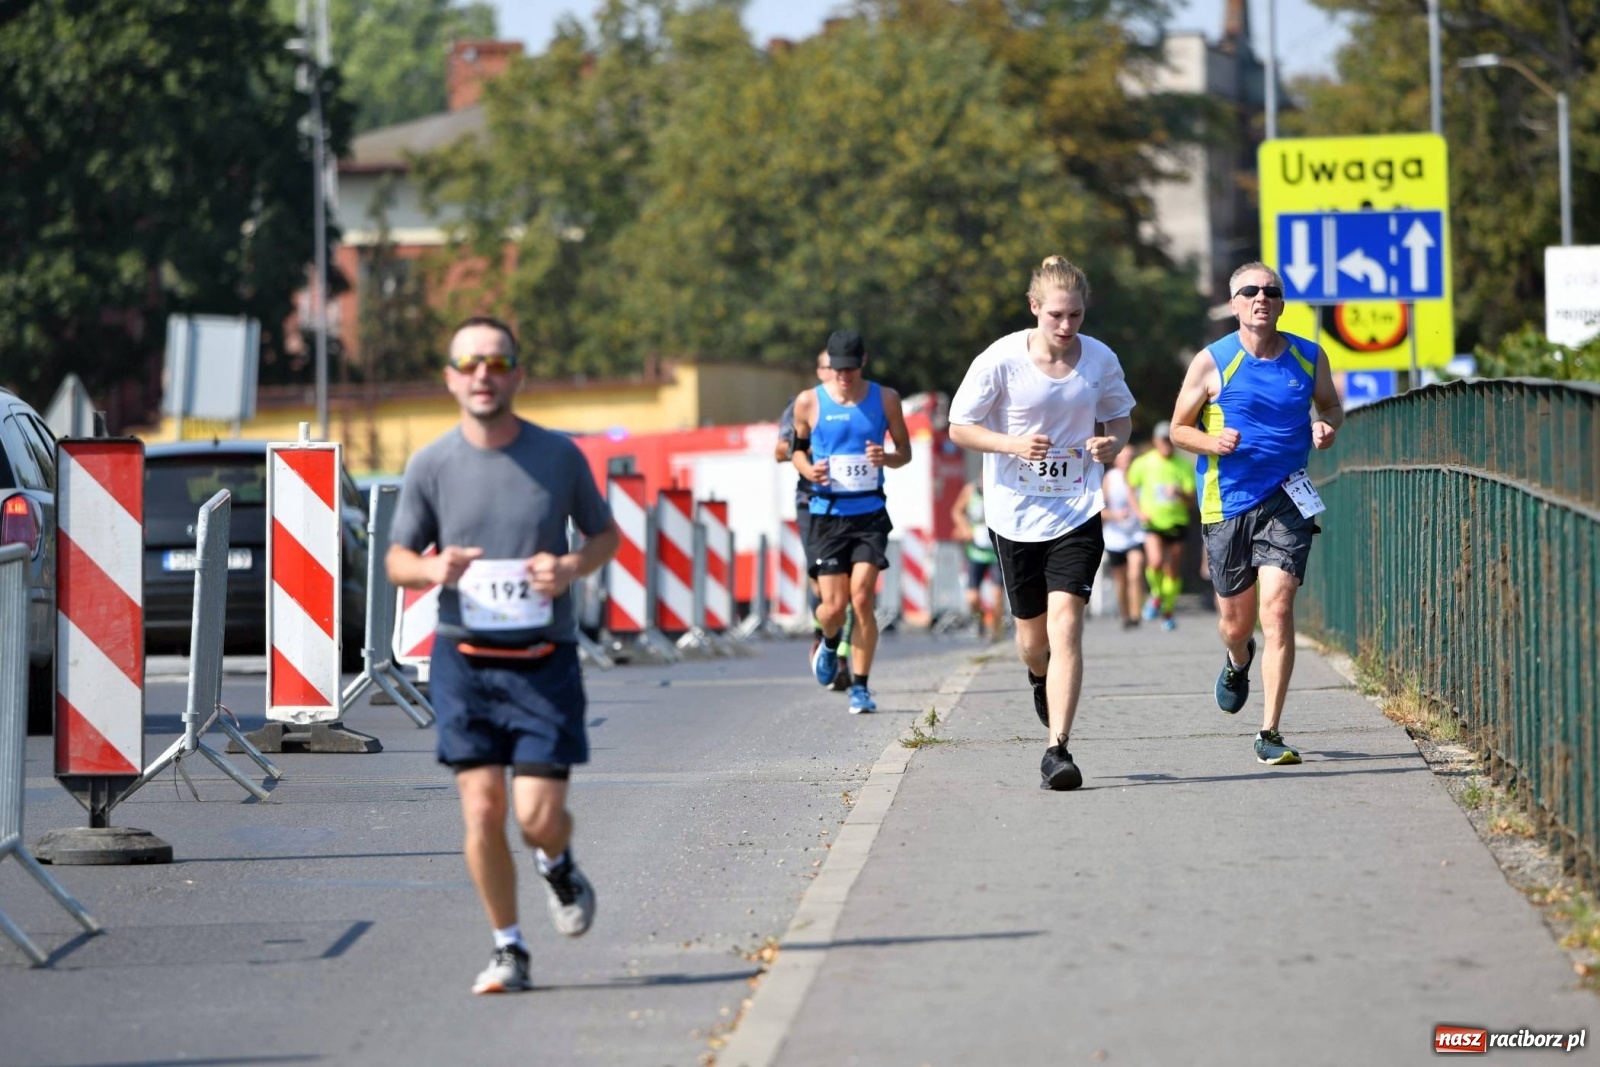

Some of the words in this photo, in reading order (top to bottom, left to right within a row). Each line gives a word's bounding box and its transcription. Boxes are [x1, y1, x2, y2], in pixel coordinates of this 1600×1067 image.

[1281, 152, 1424, 191] Uwaga
[846, 464, 868, 477] 355
[1038, 461, 1068, 478] 361
[491, 581, 529, 600] 192
